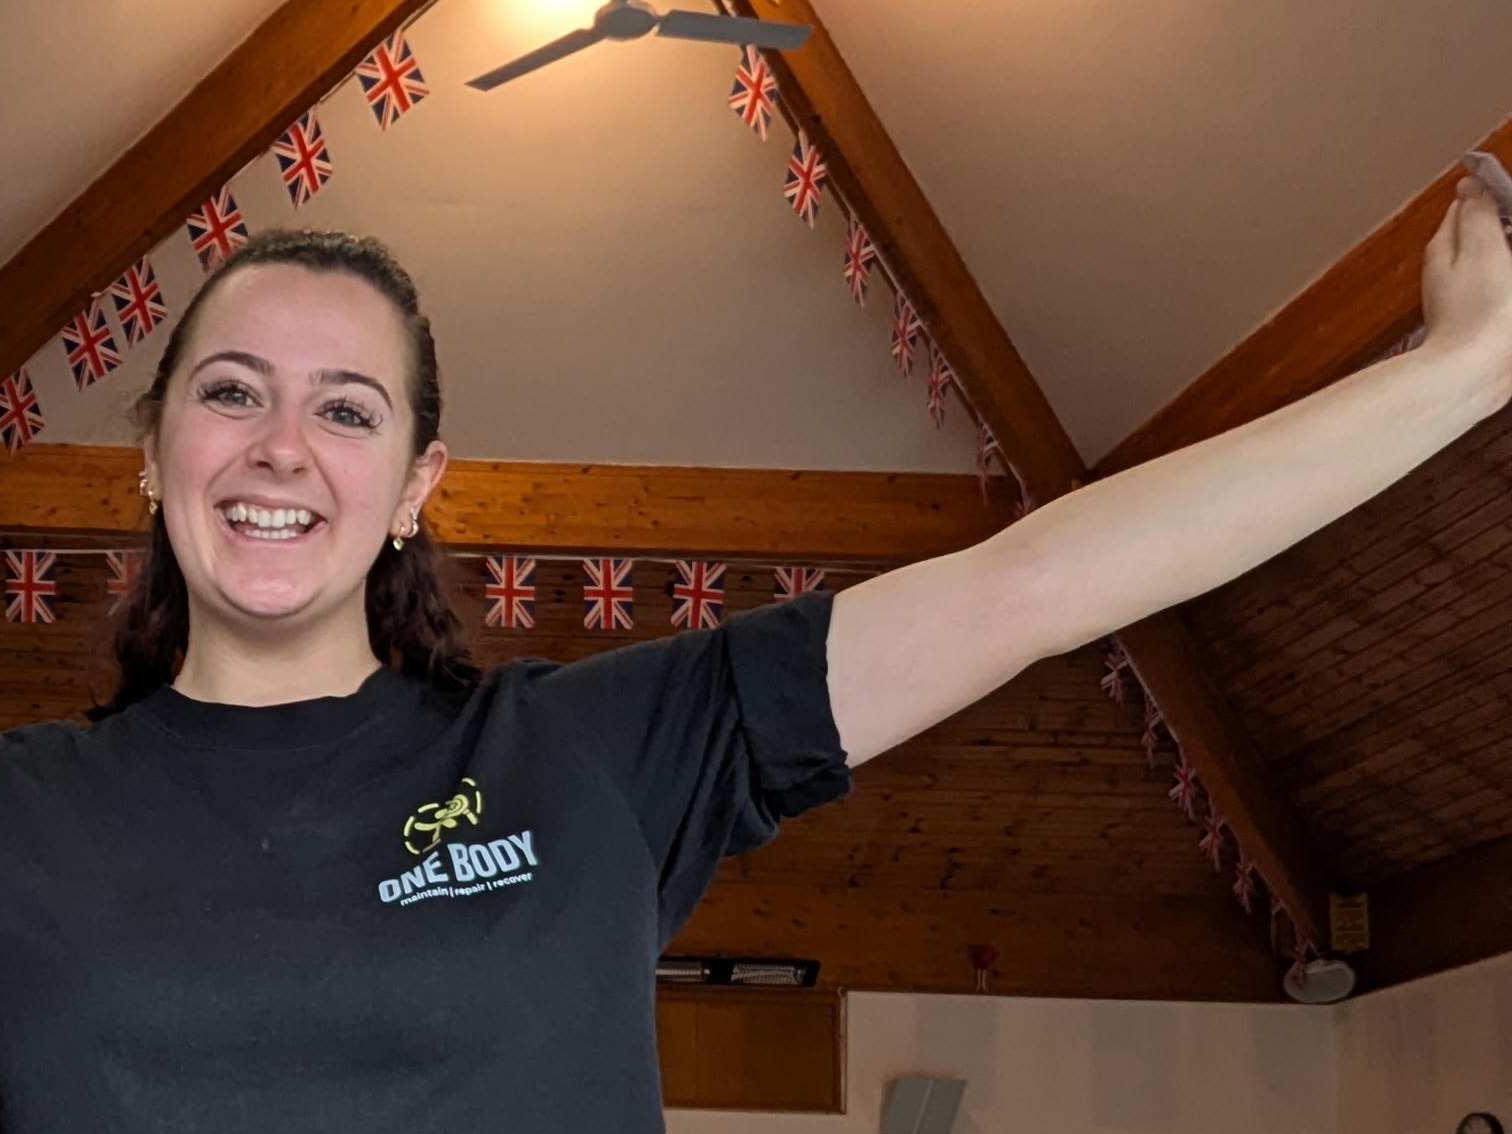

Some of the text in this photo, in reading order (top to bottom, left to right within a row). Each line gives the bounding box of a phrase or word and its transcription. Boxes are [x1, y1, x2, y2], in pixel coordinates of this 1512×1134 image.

[378, 830, 538, 902] ONE BODY
[400, 886, 449, 906] maintain
[454, 883, 485, 897] repair
[493, 871, 533, 889] recover
